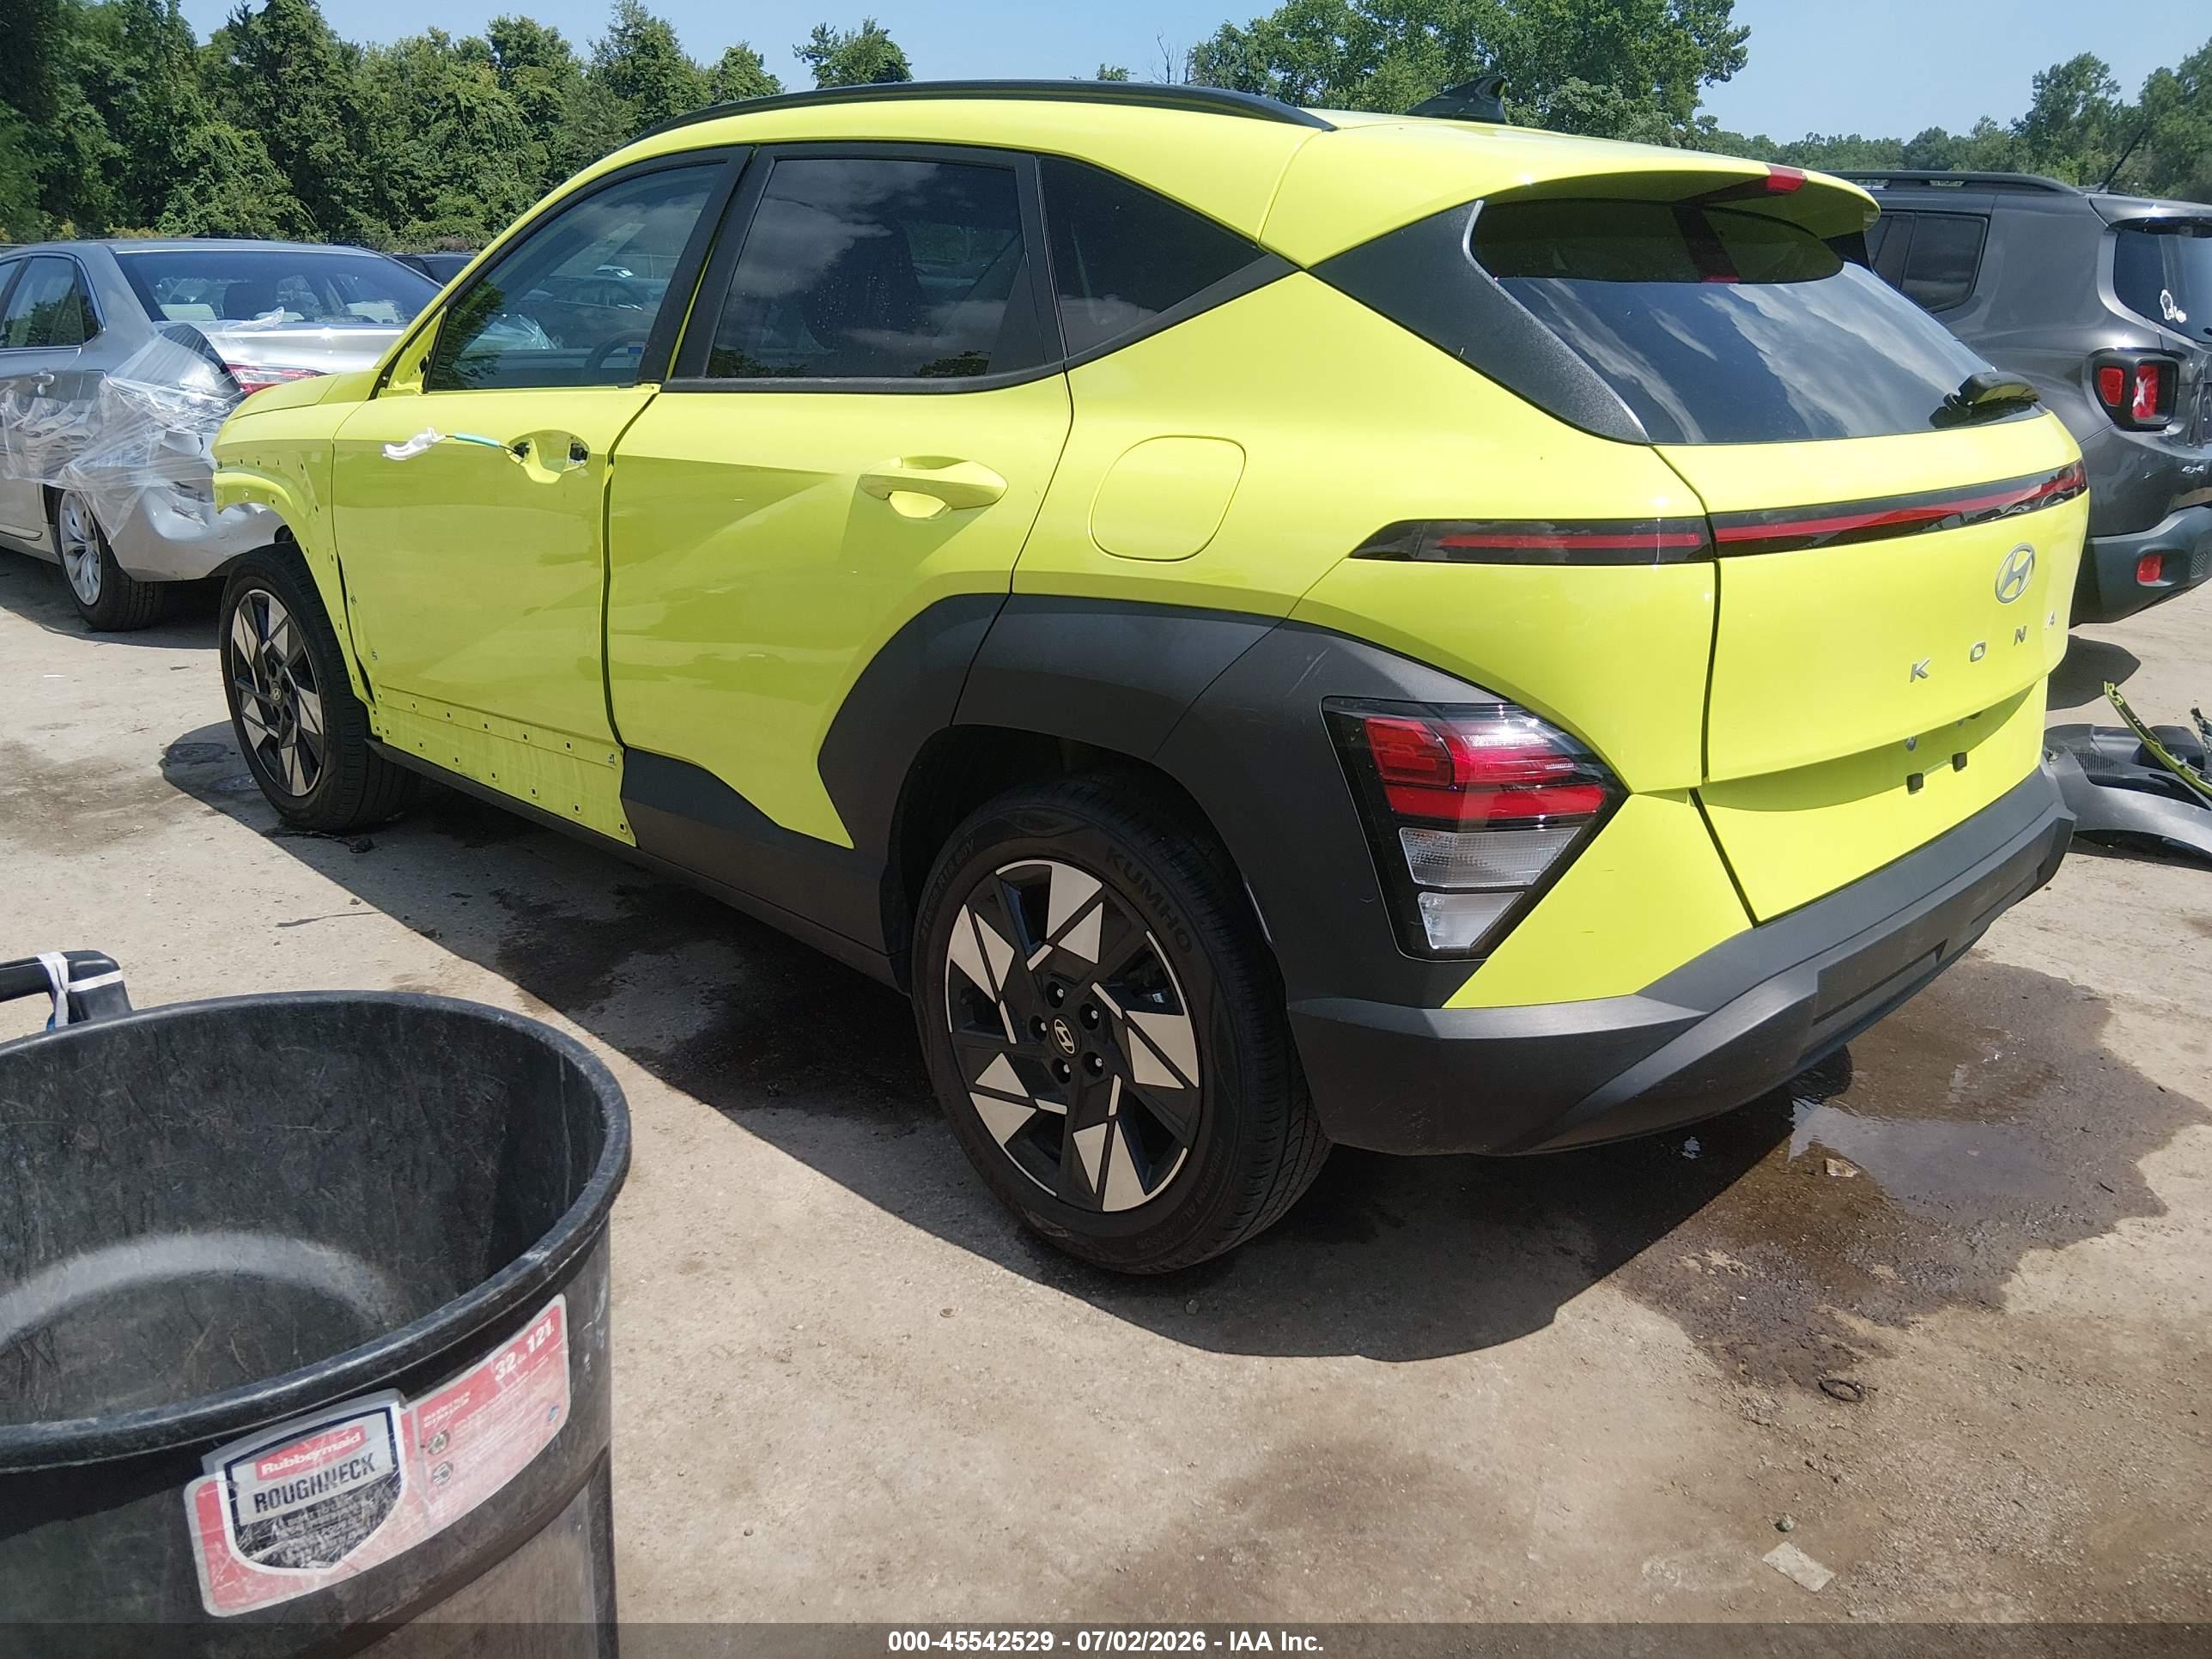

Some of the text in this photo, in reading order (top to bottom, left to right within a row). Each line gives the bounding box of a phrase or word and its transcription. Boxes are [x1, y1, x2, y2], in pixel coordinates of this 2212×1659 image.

[1909, 611, 2056, 684] KONA
[1105, 844, 1193, 953] KUMHO
[494, 1318, 551, 1382] 32 121
[253, 1452, 376, 1514] ROUGHNECK
[260, 1431, 362, 1476] Rubbermaid
